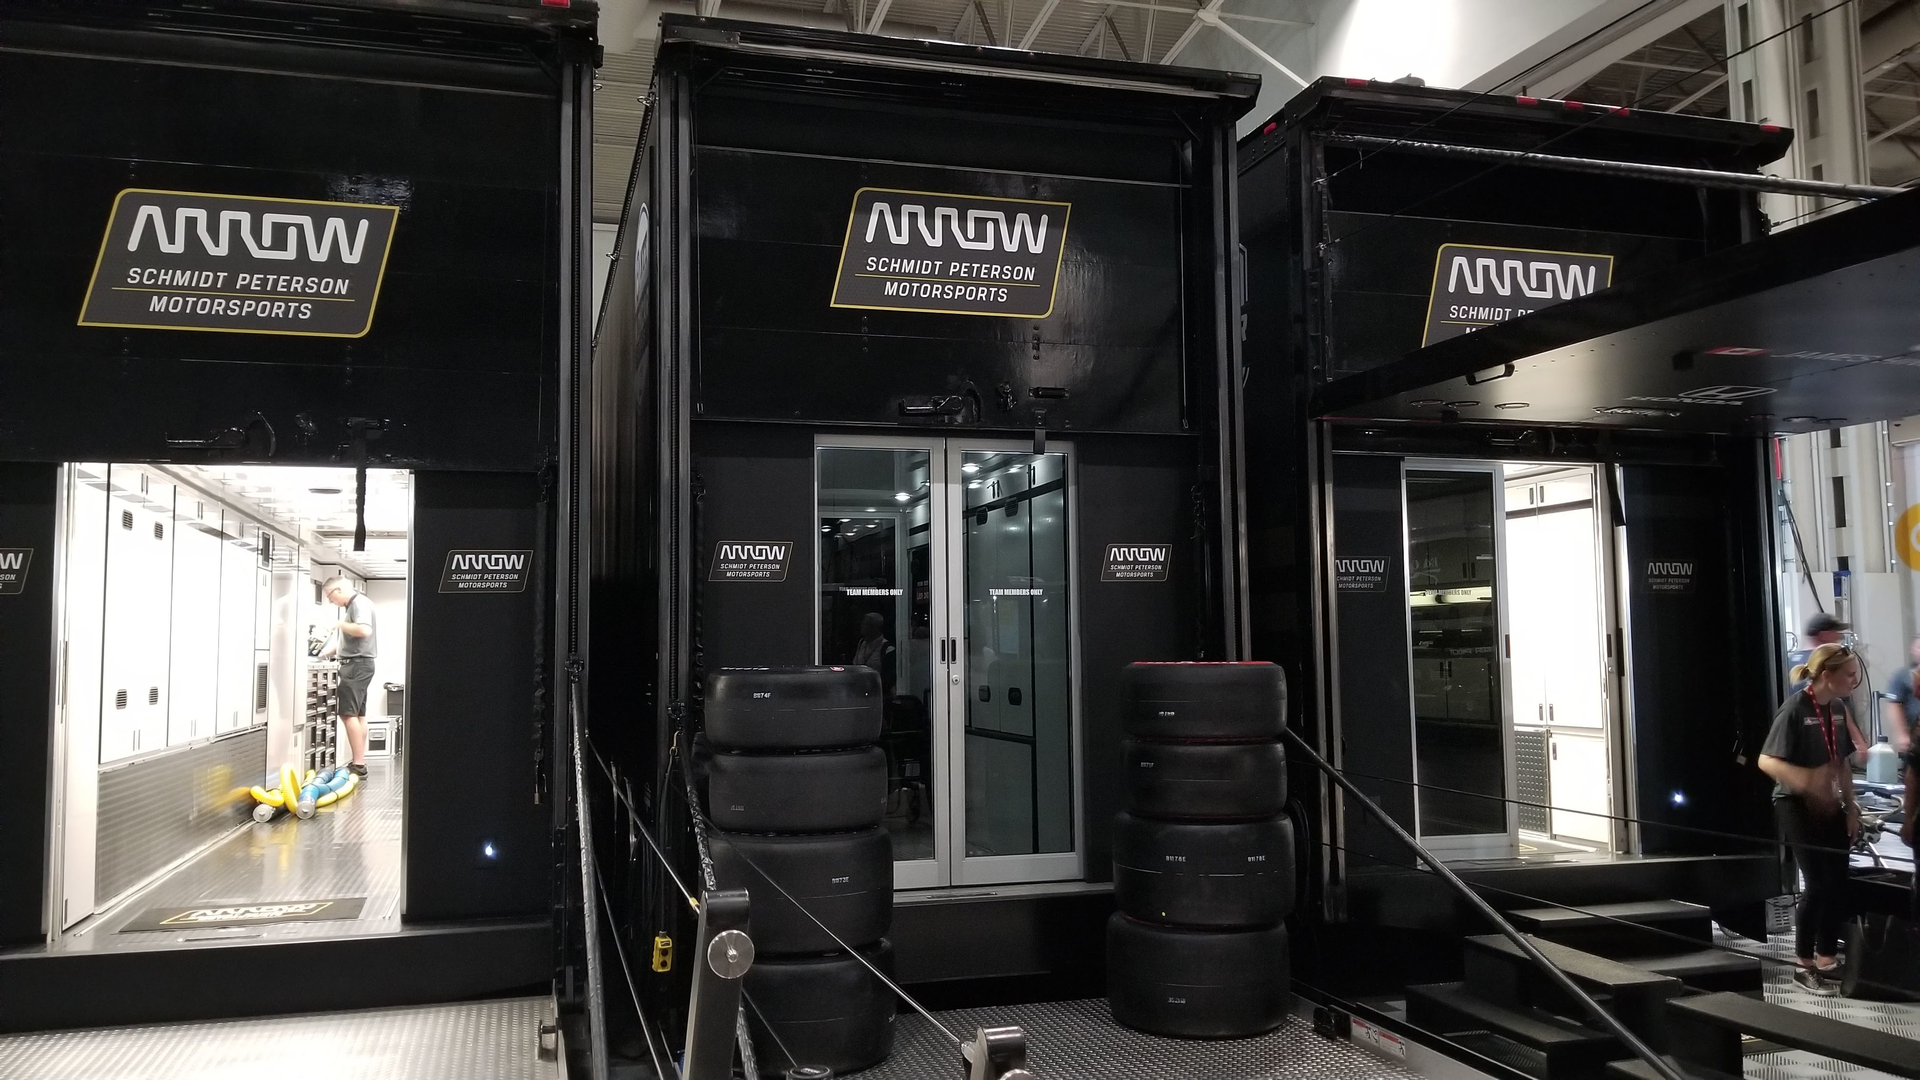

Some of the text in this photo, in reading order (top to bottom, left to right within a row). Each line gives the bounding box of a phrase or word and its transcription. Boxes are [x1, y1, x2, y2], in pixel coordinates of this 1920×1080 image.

[128, 205, 369, 264] ARROW
[866, 202, 1048, 253] ARROW
[866, 257, 1035, 281] SCHMIDT PETERSON
[1448, 256, 1595, 300] ARROW
[127, 268, 349, 295] SCHMIDT PETERSON
[884, 282, 1008, 302] MOTORSPORTS
[149, 296, 312, 319] MOTORSPORTS
[1450, 305, 1512, 321] SCHMIDT
[451, 554, 524, 570] ARROW
[720, 545, 785, 560] ARROW
[1110, 547, 1166, 562] ARROW
[1648, 562, 1693, 575] ARROW
[989, 588, 1043, 596] TEAM MEMBERS ONLY
